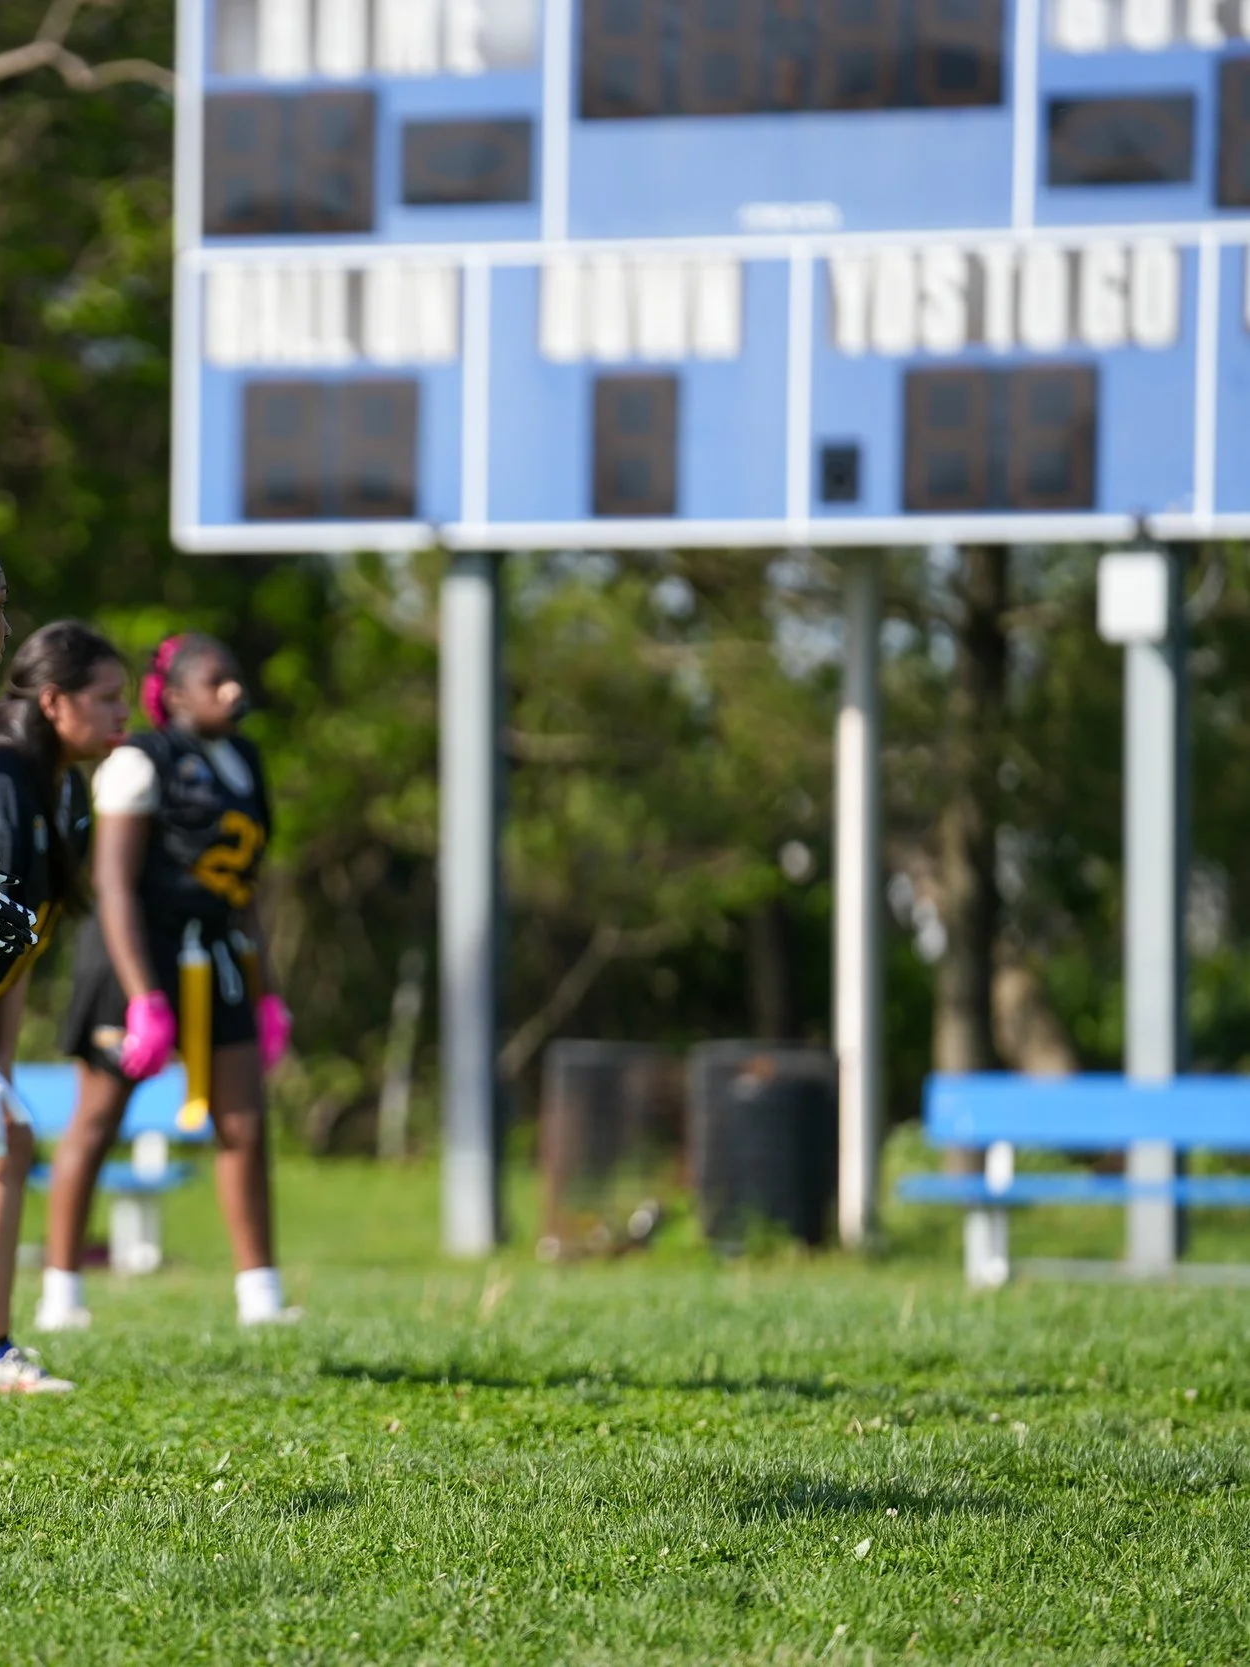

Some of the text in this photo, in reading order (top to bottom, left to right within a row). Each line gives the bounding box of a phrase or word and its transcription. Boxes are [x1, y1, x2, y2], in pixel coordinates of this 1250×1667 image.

[829, 244, 969, 356] YDS
[979, 243, 1069, 353] TO
[1078, 238, 1181, 350] GO
[193, 810, 262, 909] 2
